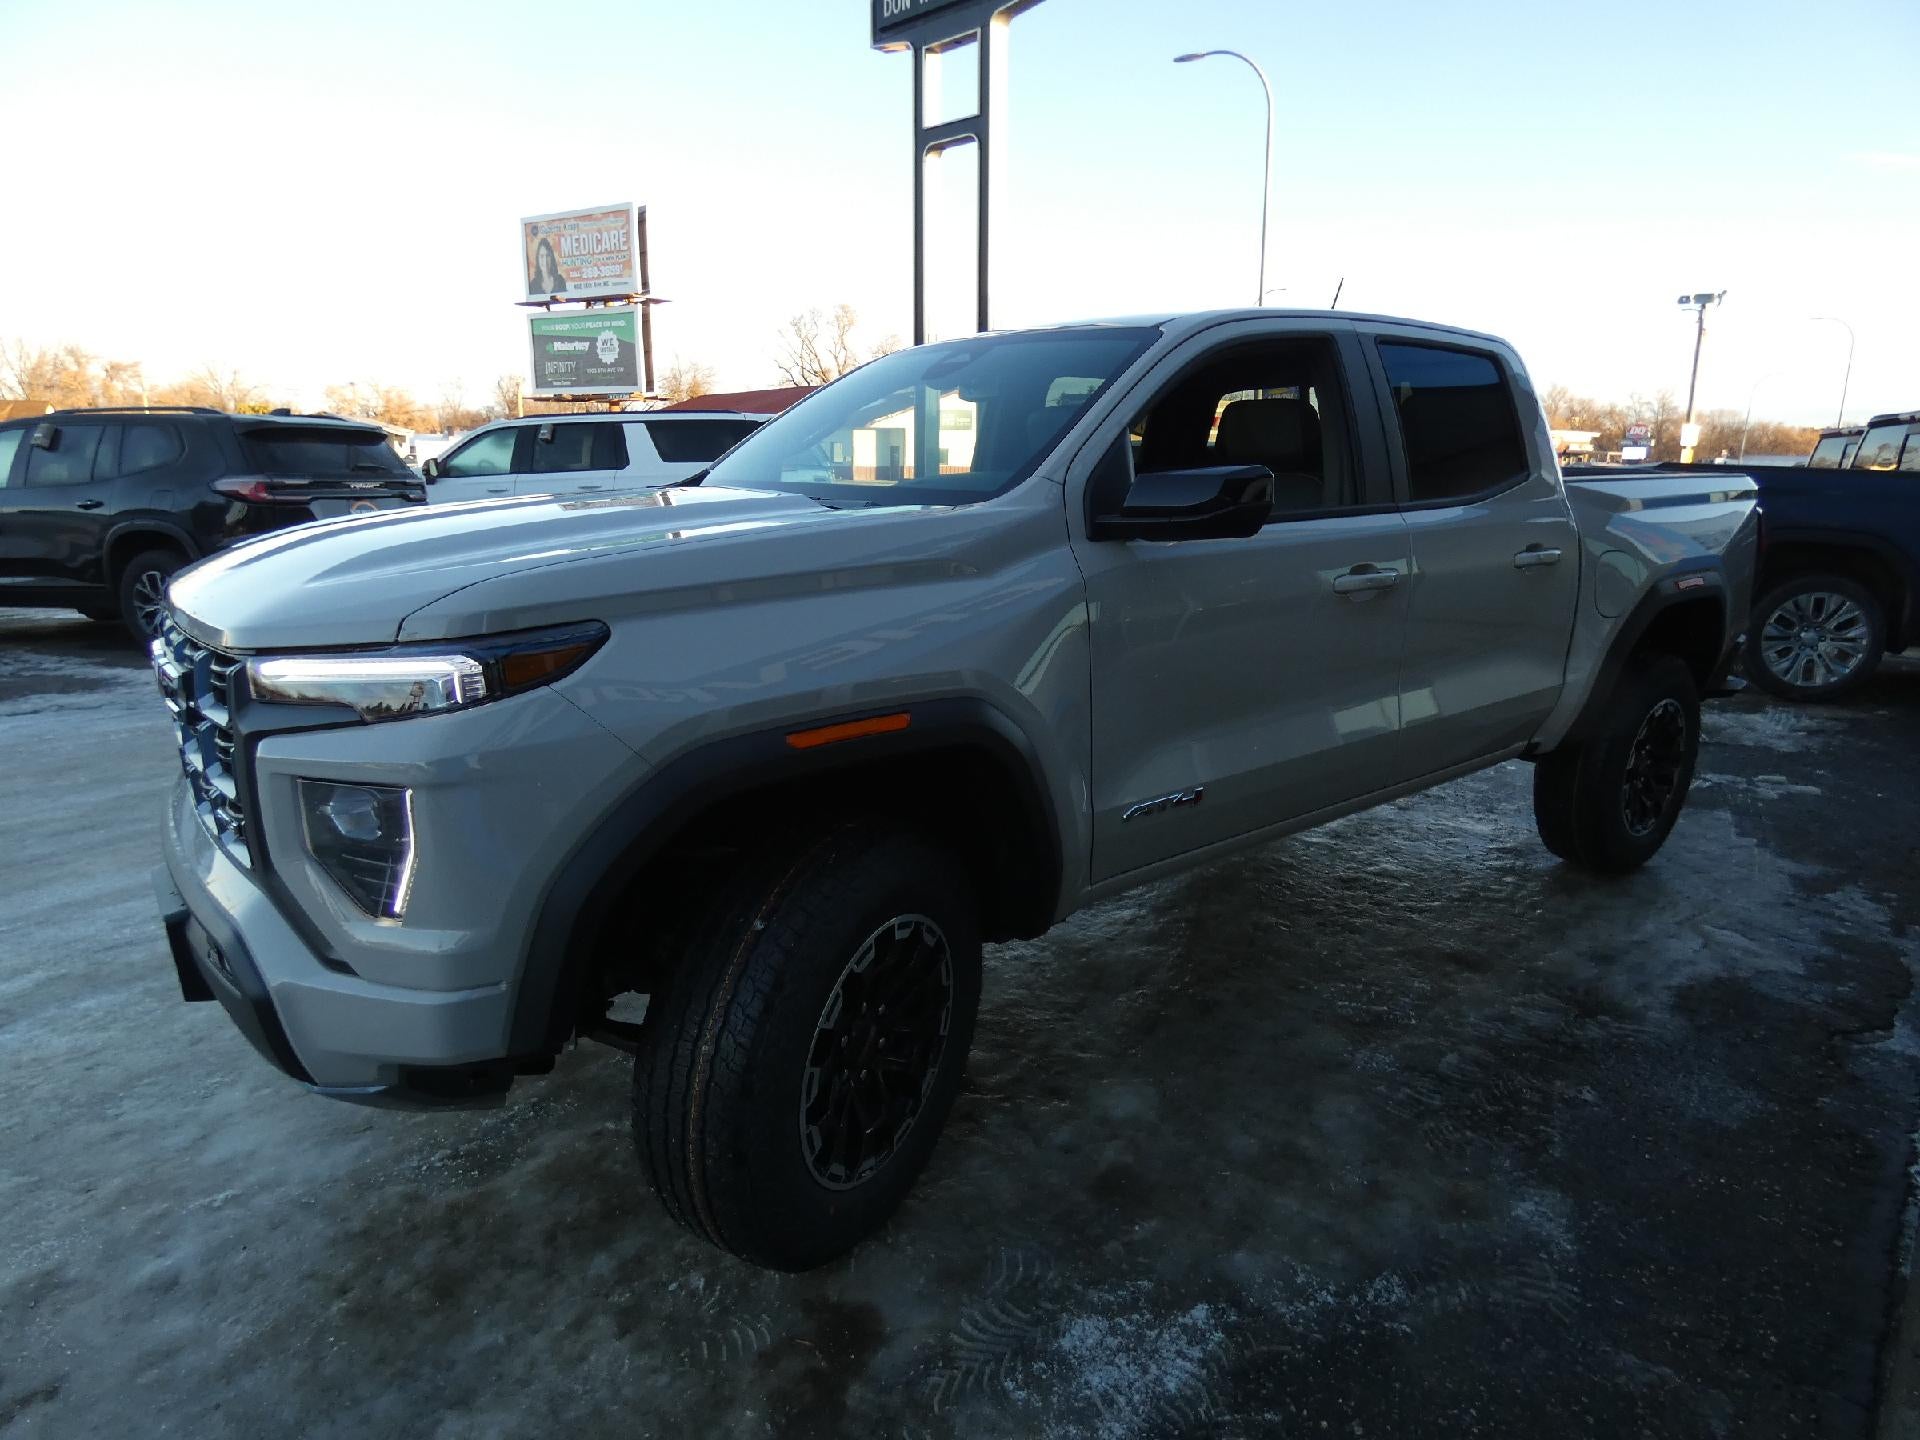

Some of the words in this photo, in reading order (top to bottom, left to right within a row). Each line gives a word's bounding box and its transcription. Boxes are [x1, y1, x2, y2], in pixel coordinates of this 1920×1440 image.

[561, 229, 628, 257] MEDICARE
[601, 338, 614, 346] WE
[545, 361, 576, 374] INFINITY
